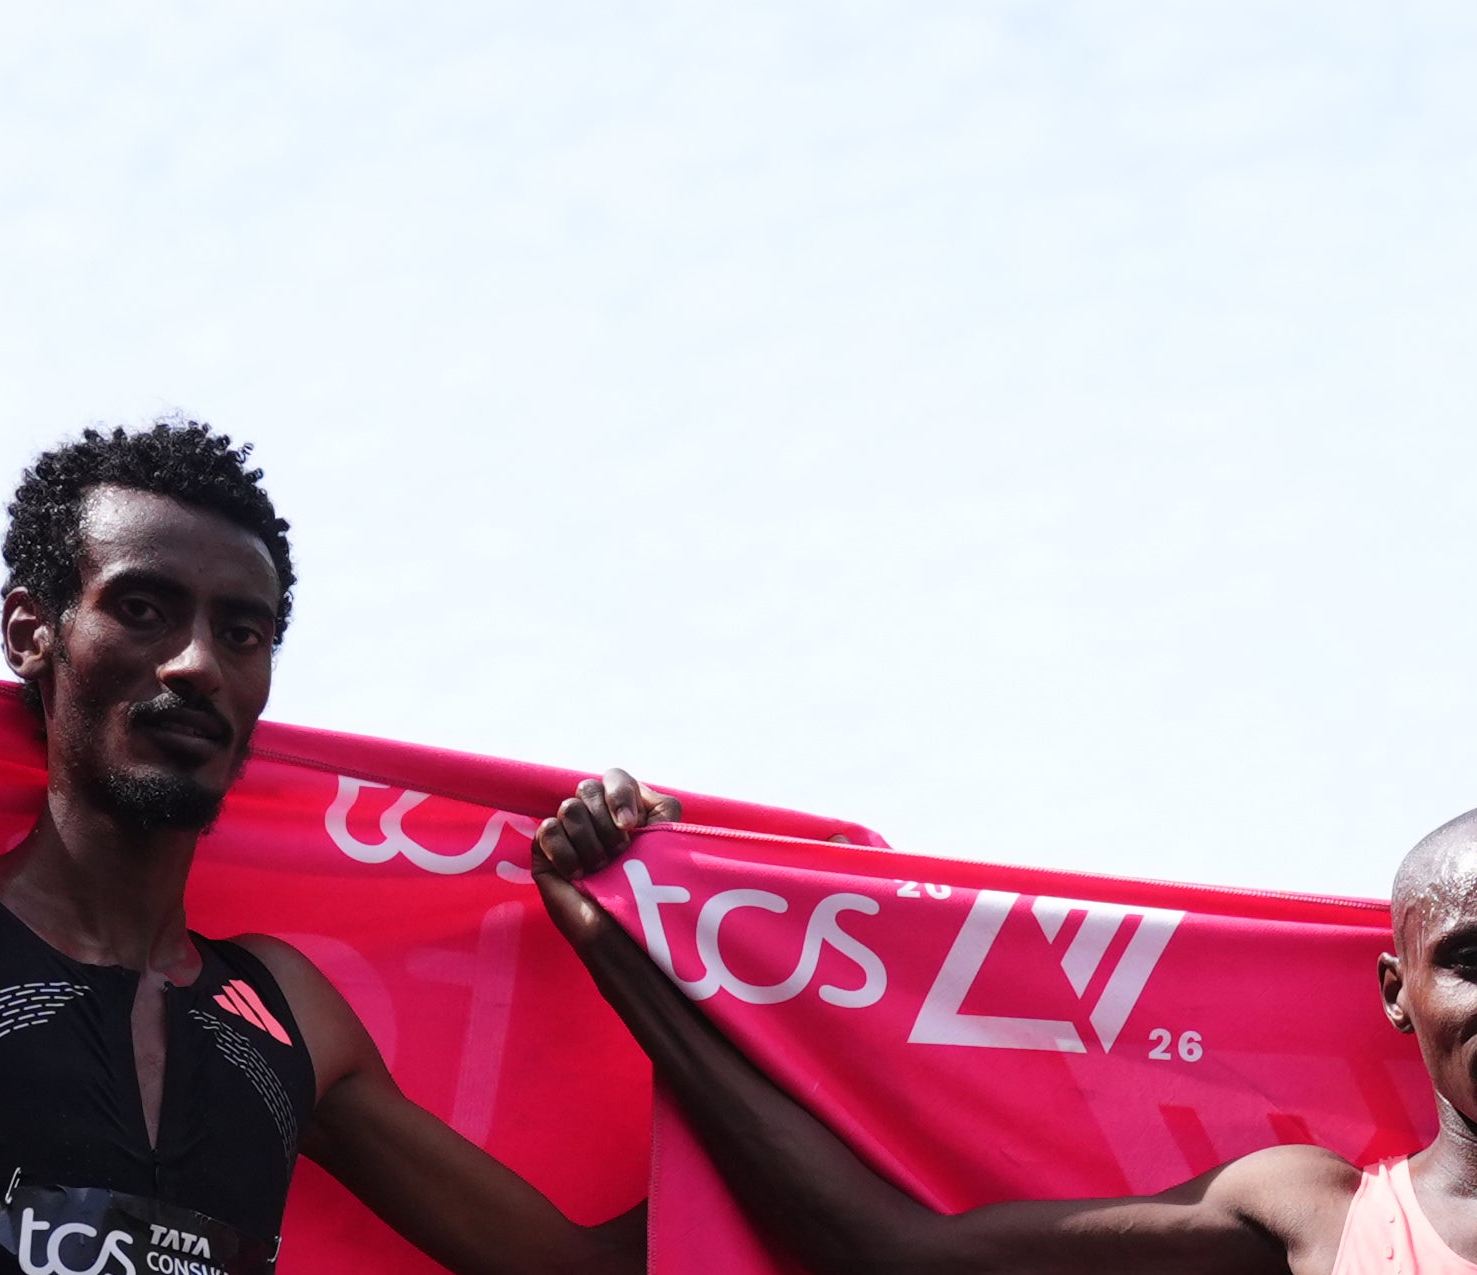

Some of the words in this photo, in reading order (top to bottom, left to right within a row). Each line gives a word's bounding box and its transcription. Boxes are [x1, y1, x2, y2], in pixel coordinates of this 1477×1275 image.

[623, 858, 889, 1009] tcs
[1147, 1028, 1204, 1063] 26
[149, 1223, 212, 1260] TATA
